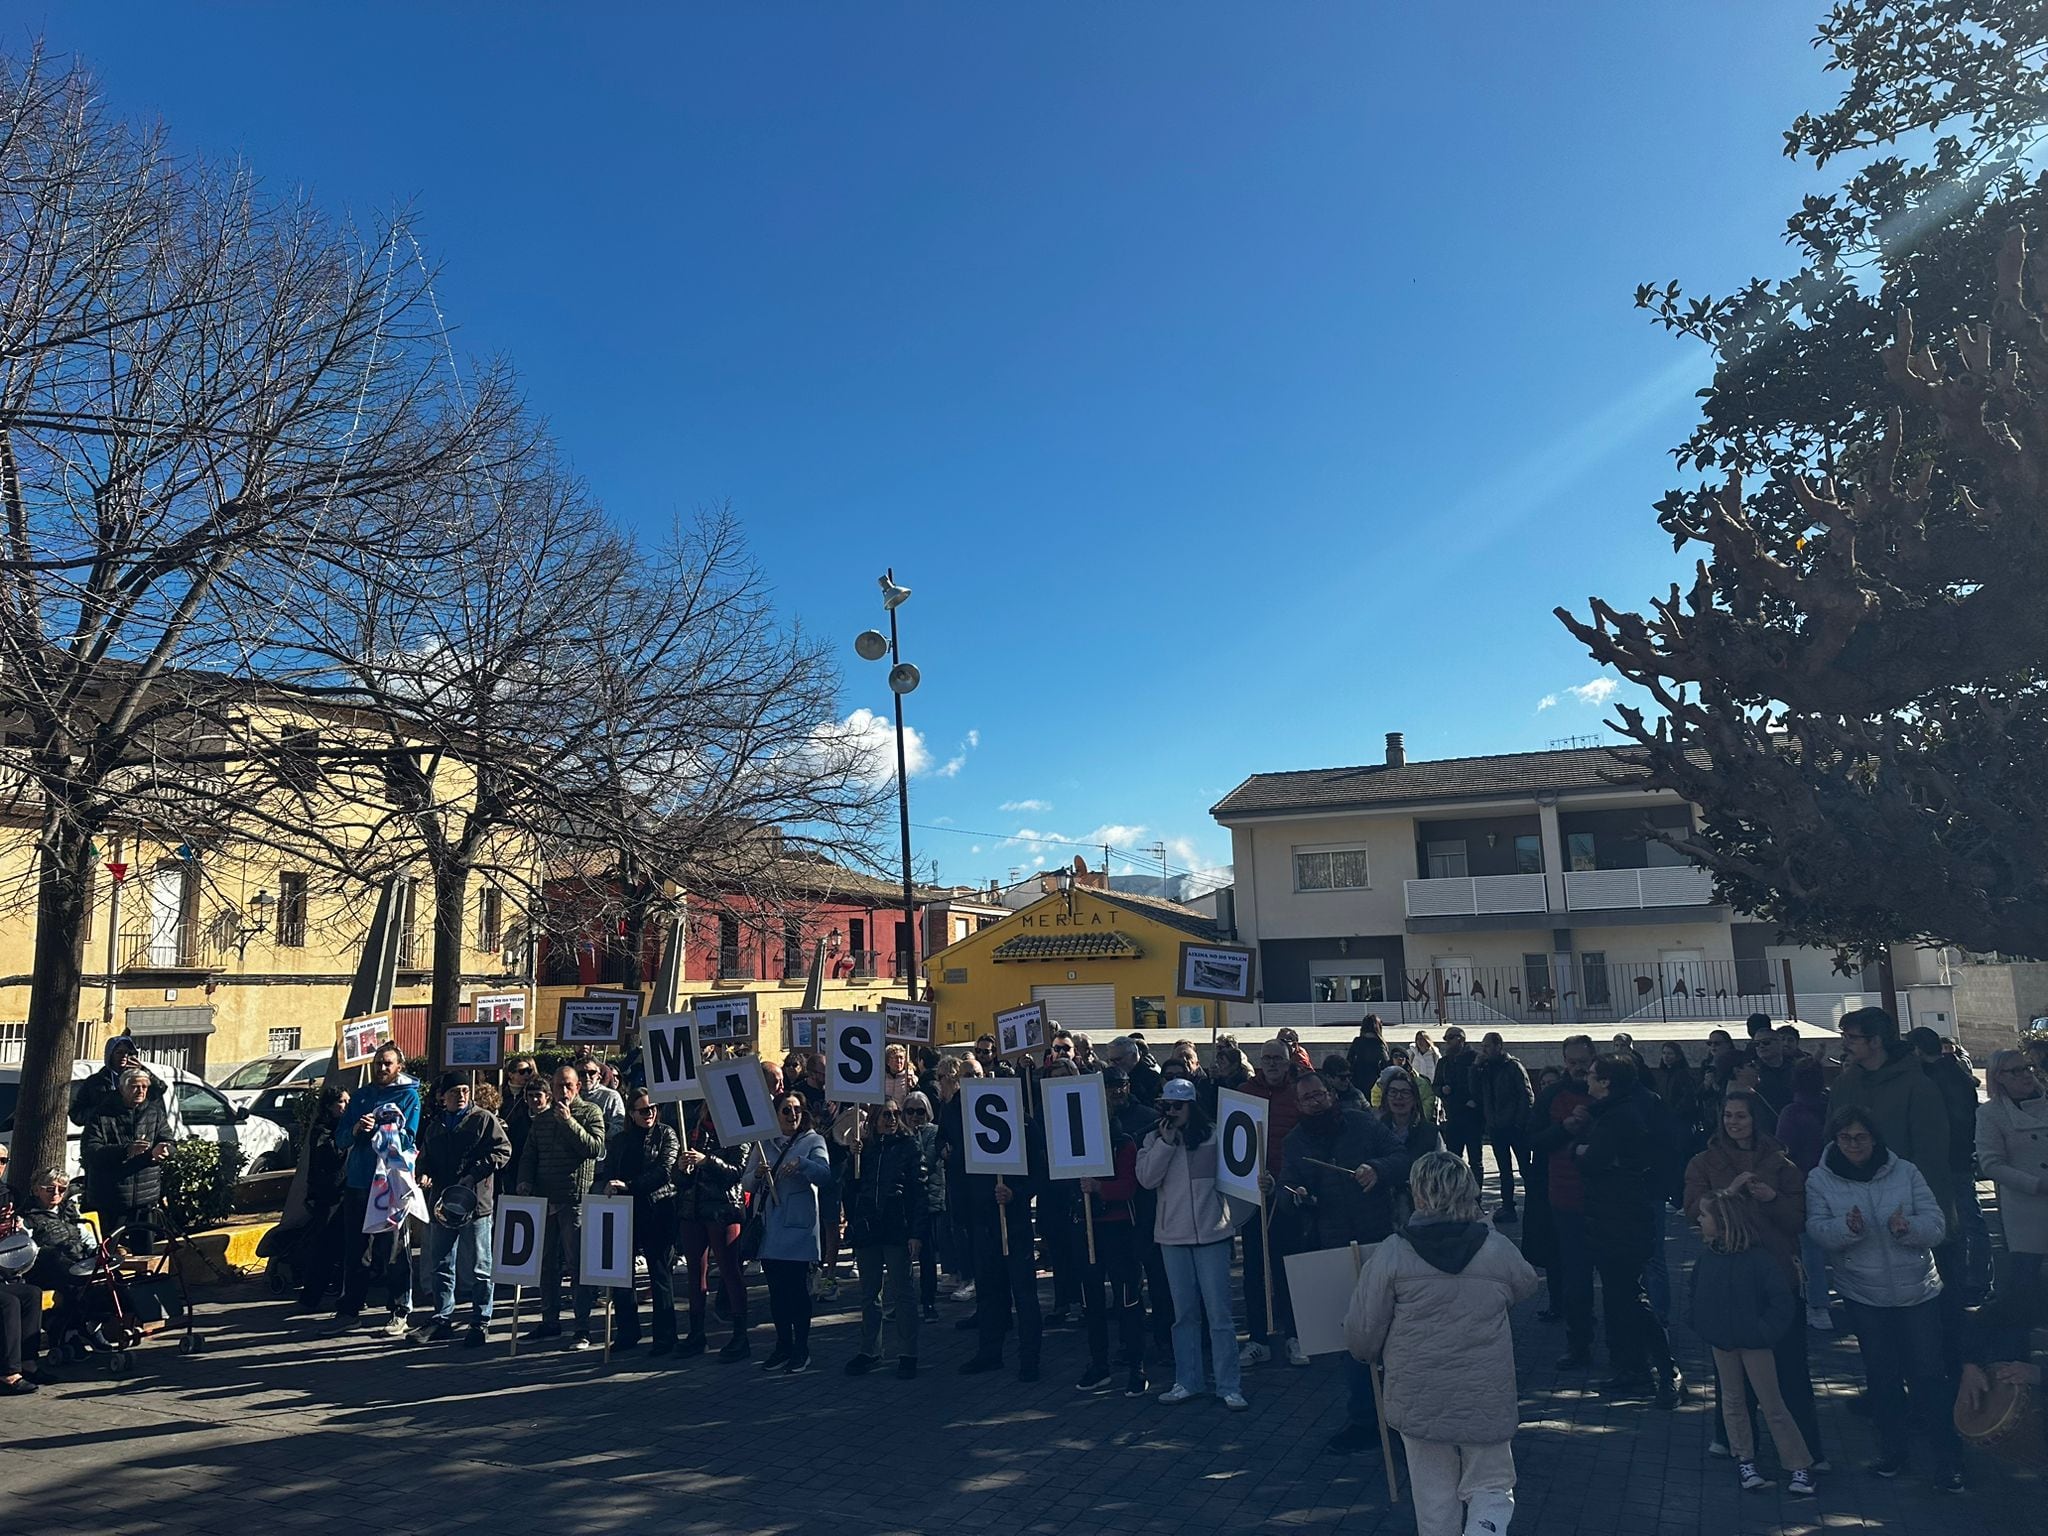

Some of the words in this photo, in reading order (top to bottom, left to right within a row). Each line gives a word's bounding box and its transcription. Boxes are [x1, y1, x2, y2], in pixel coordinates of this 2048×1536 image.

[1022, 911, 1118, 928] MERCAT
[648, 1025, 696, 1083] M
[838, 1026, 873, 1084] S
[725, 1073, 755, 1127] I
[975, 1093, 1012, 1154] S
[1066, 1092, 1086, 1157] I
[501, 1209, 535, 1266] D
[601, 1212, 614, 1270] I
